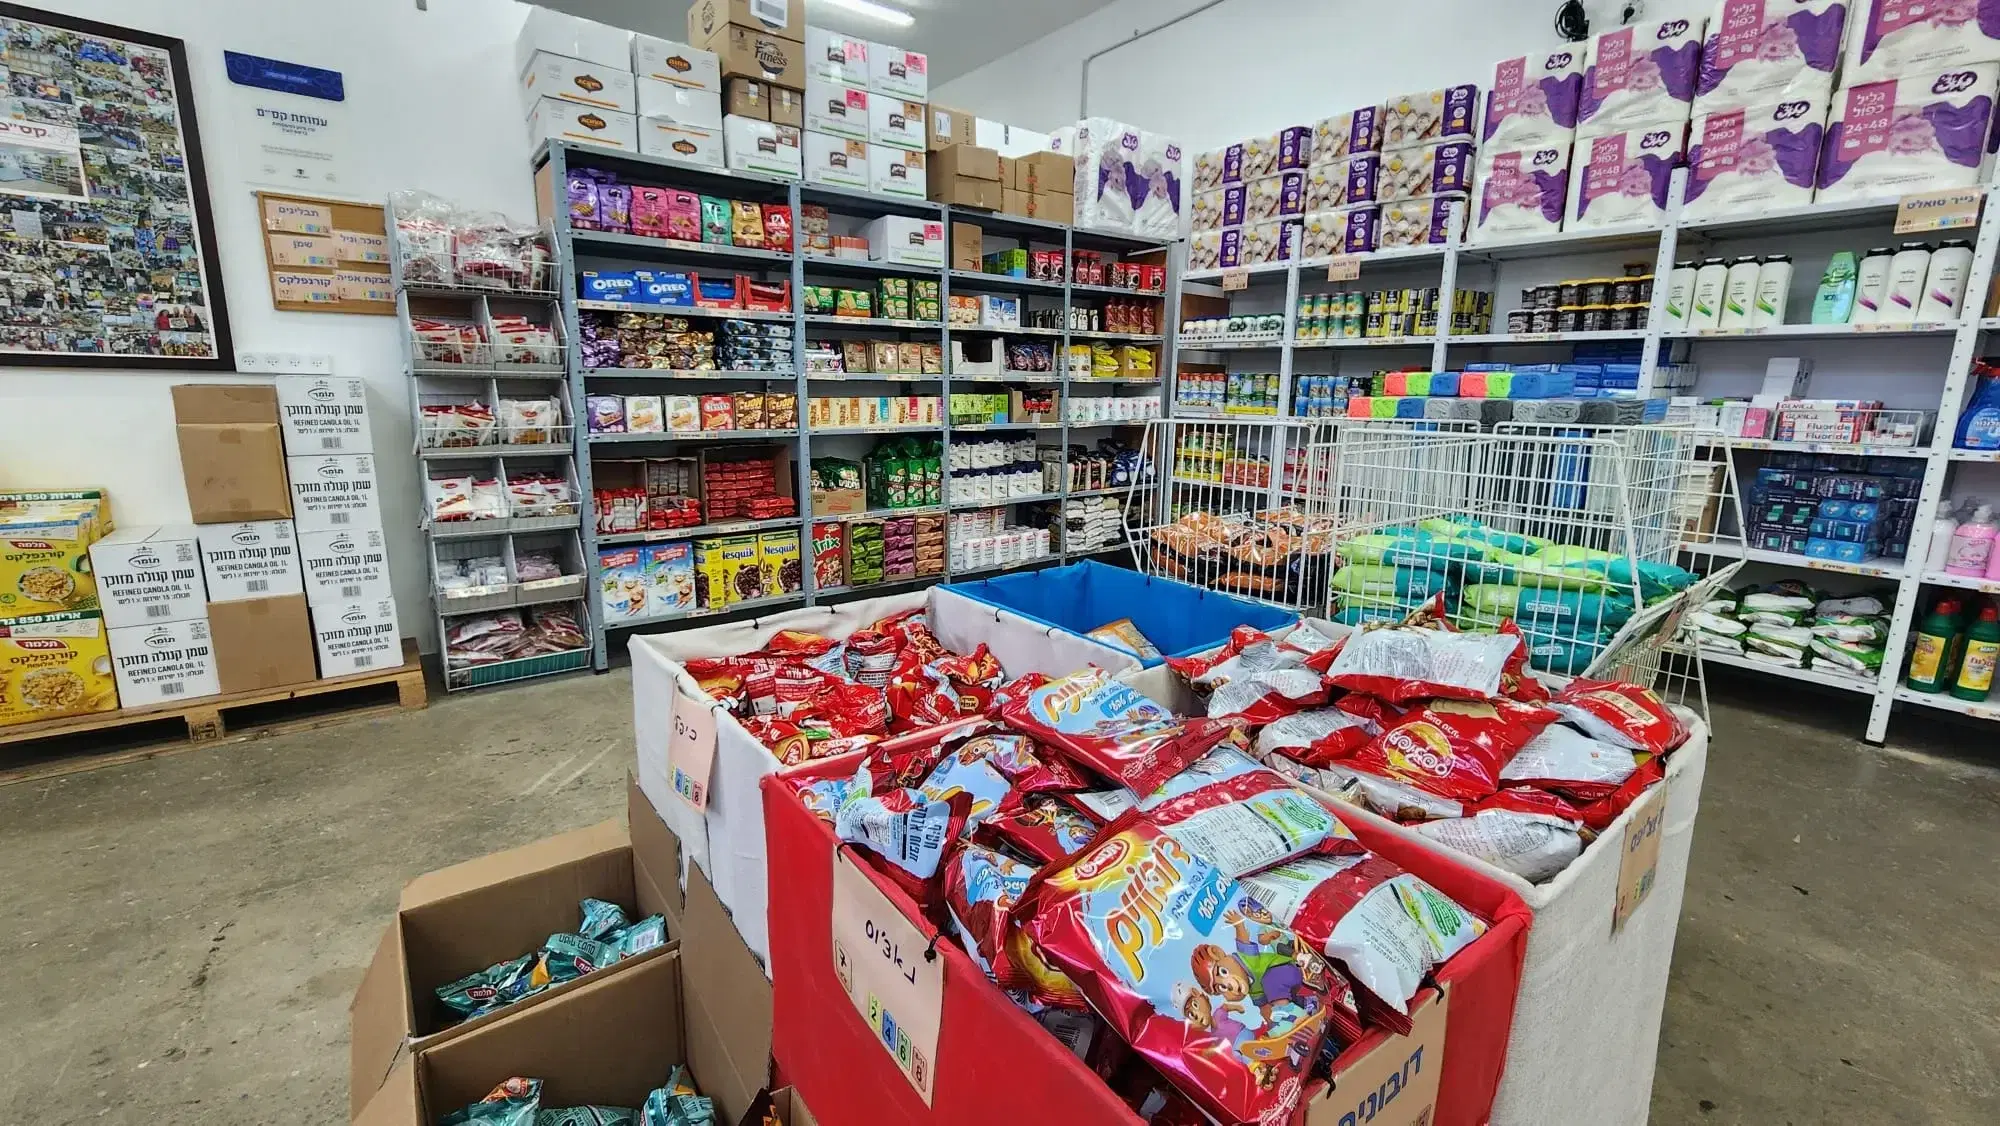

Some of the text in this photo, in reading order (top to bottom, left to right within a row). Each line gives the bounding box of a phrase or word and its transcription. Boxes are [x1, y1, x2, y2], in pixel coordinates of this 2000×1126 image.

[1727, 16, 1755, 27] כפול
[755, 45, 788, 67] Fitness
[1601, 50, 1624, 60] כפול
[1852, 105, 1884, 117] כפול
[1709, 130, 1734, 140] כפול
[1596, 154, 1618, 163] כפול
[1907, 196, 1975, 210] נייר טואלט
[293, 240, 313, 249] שמן
[278, 277, 331, 288] קורנפלקס
[593, 278, 634, 290] OREO
[650, 283, 686, 295] OREO
[284, 405, 363, 416] שמן קנולה מזוכך
[1806, 422, 1852, 432] Fluoride
[1805, 432, 1850, 442] Fluoride
[294, 481, 371, 494] שמן קנולה מזוכך
[25, 494, 47, 502] 850
[237, 534, 260, 542] תומר
[207, 546, 291, 563] שמן קנולה מזוכך
[764, 543, 797, 557] Nesquik
[5, 551, 64, 563] קורנפלקס
[307, 553, 382, 570] שמן קנולה מזוכך
[102, 568, 194, 588] שמן קנולה מזוכך
[316, 570, 339, 578] REFINED
[113, 587, 142, 596] REFINED
[143, 585, 169, 594] CANOLA
[20, 616, 42, 625] 850
[320, 623, 392, 642] שמן קנולה מזוכך
[328, 642, 351, 650] REFINED
[10, 650, 78, 666] קורנפלקס
[117, 646, 208, 668] שמן קנולה מזוכך
[128, 668, 156, 676] REFINED
[158, 664, 184, 673] CANOLA
